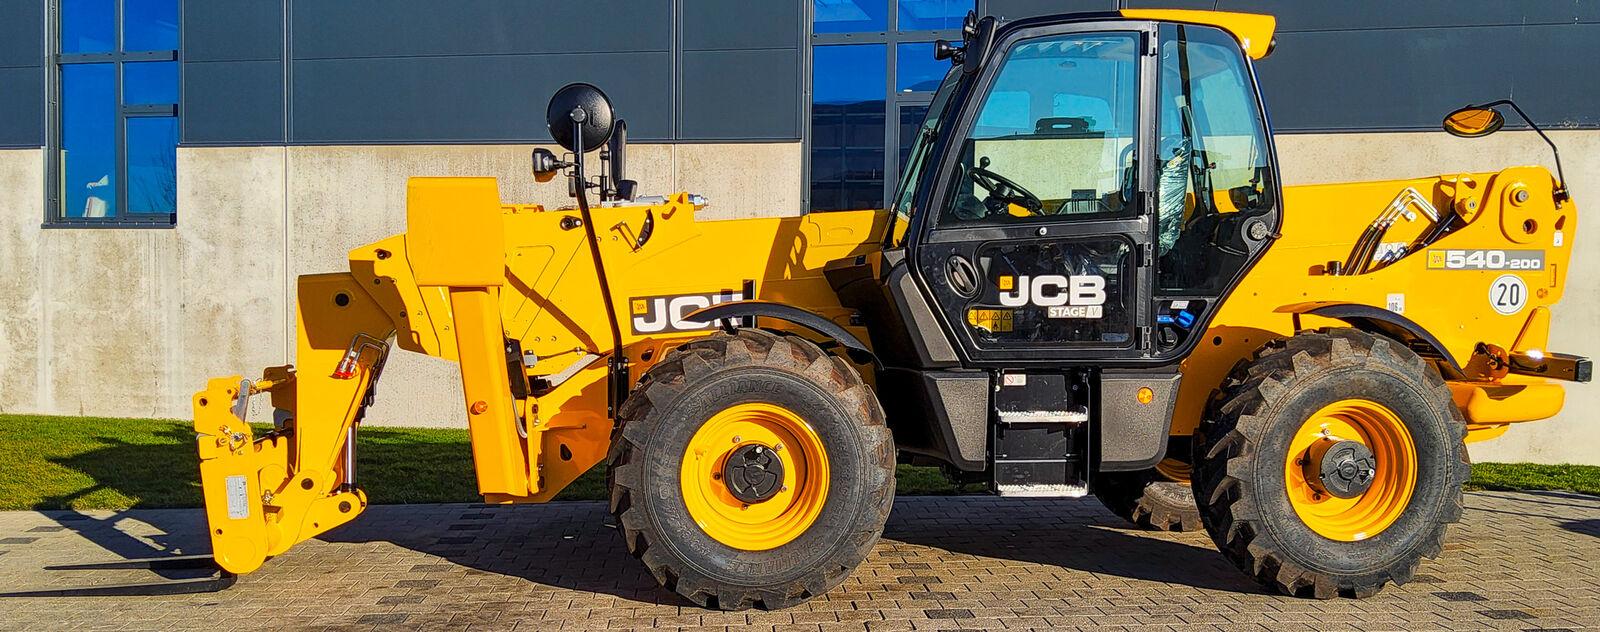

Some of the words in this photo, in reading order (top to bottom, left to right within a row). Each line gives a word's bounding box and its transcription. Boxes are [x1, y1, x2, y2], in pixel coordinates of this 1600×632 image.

[1446, 250, 1541, 269] 540-200
[1000, 275, 1106, 306] JCB
[1497, 283, 1520, 306] 20
[1049, 307, 1086, 317] STAGE
[699, 380, 785, 412] ALLIANCE
